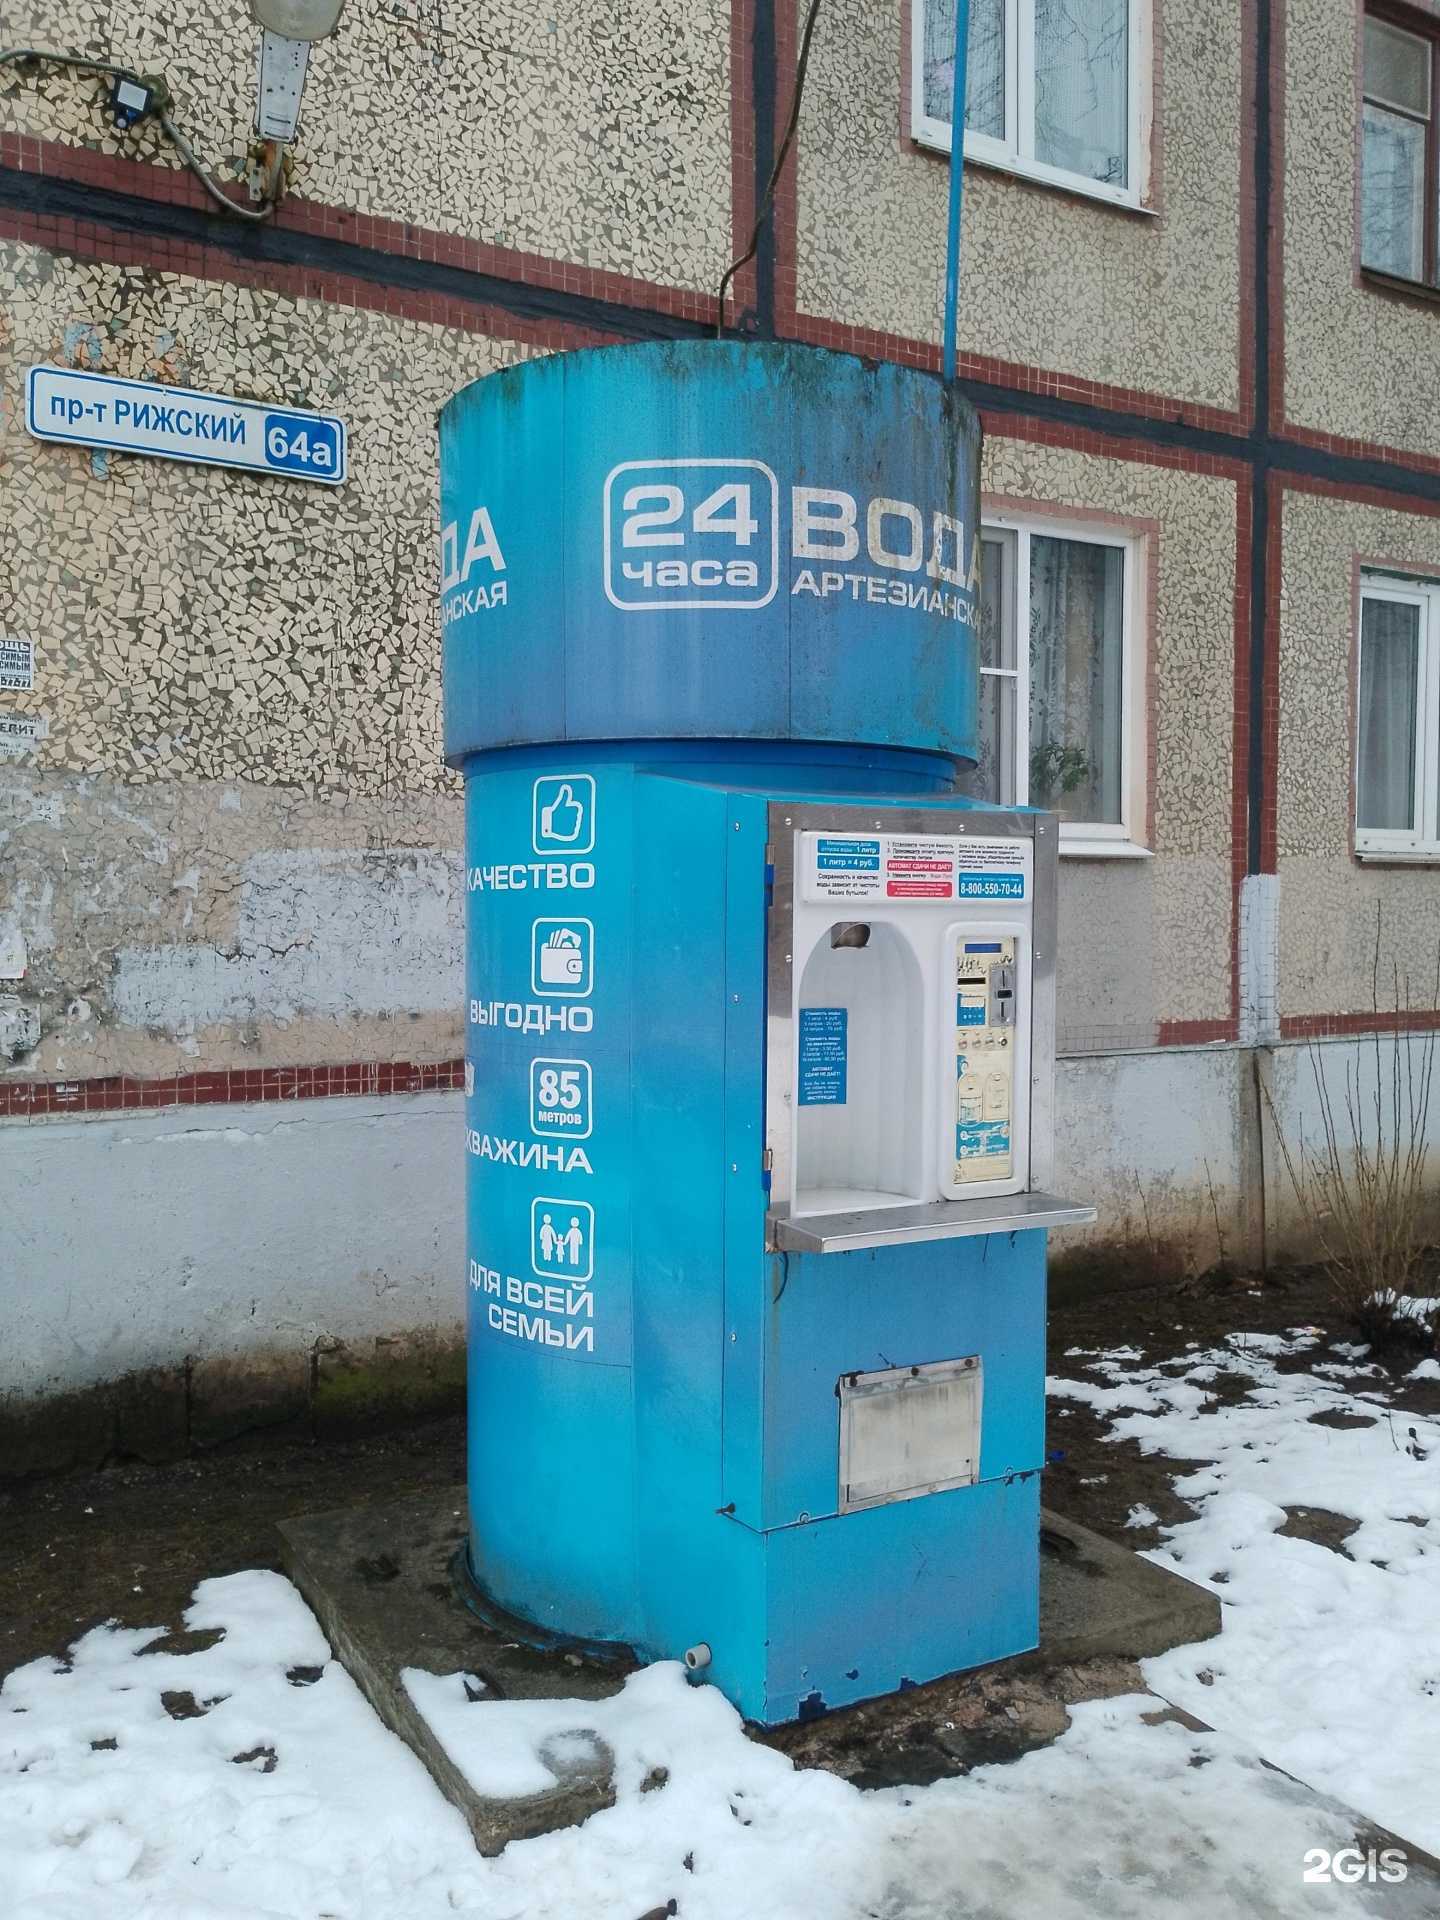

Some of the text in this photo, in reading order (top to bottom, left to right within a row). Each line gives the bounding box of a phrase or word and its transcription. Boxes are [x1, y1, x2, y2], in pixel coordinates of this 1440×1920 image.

[51, 396, 332, 467] пр-т РИЖСКИЙ 64а
[622, 484, 759, 548] 24
[622, 559, 758, 588] часа
[467, 862, 596, 891] КАЧЕСТВО
[829, 859, 846, 867] литр
[961, 882, 1022, 895] 8-800-550-70-44
[470, 999, 594, 1035] ВЫГОДНО
[538, 1069, 582, 1109] 85
[538, 1111, 582, 1126] метров
[470, 1258, 594, 1318] ДЛЯ ВСЕЙ
[488, 1303, 594, 1352] СЕМЬИ
